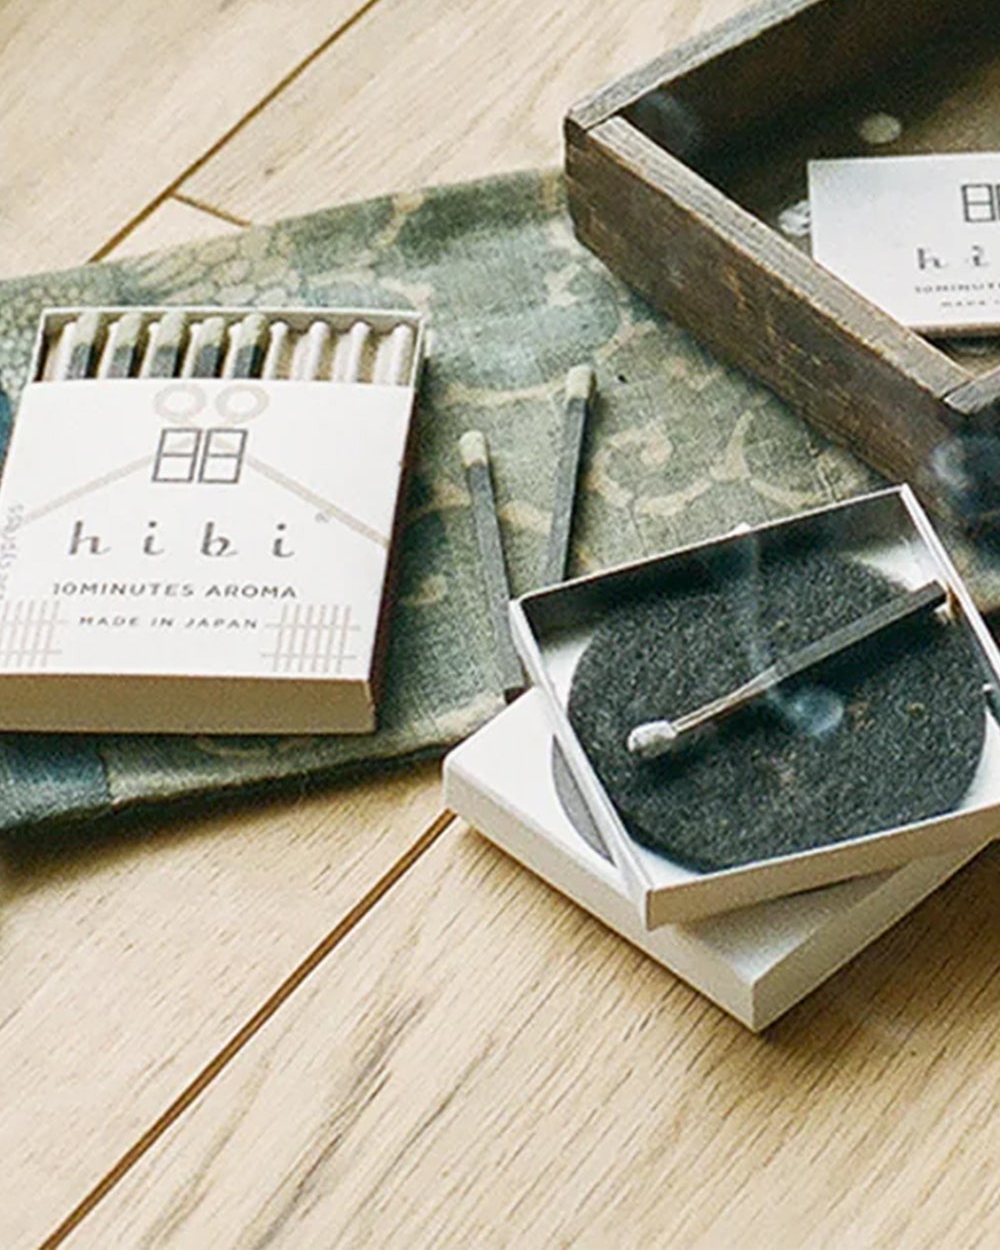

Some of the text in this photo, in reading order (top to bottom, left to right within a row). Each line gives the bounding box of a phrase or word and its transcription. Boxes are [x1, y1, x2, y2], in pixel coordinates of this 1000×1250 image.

[68, 520, 295, 558] hibi
[53, 582, 298, 599] 10MINUTES AROMA
[79, 616, 258, 629] MADE IN JAPAN
